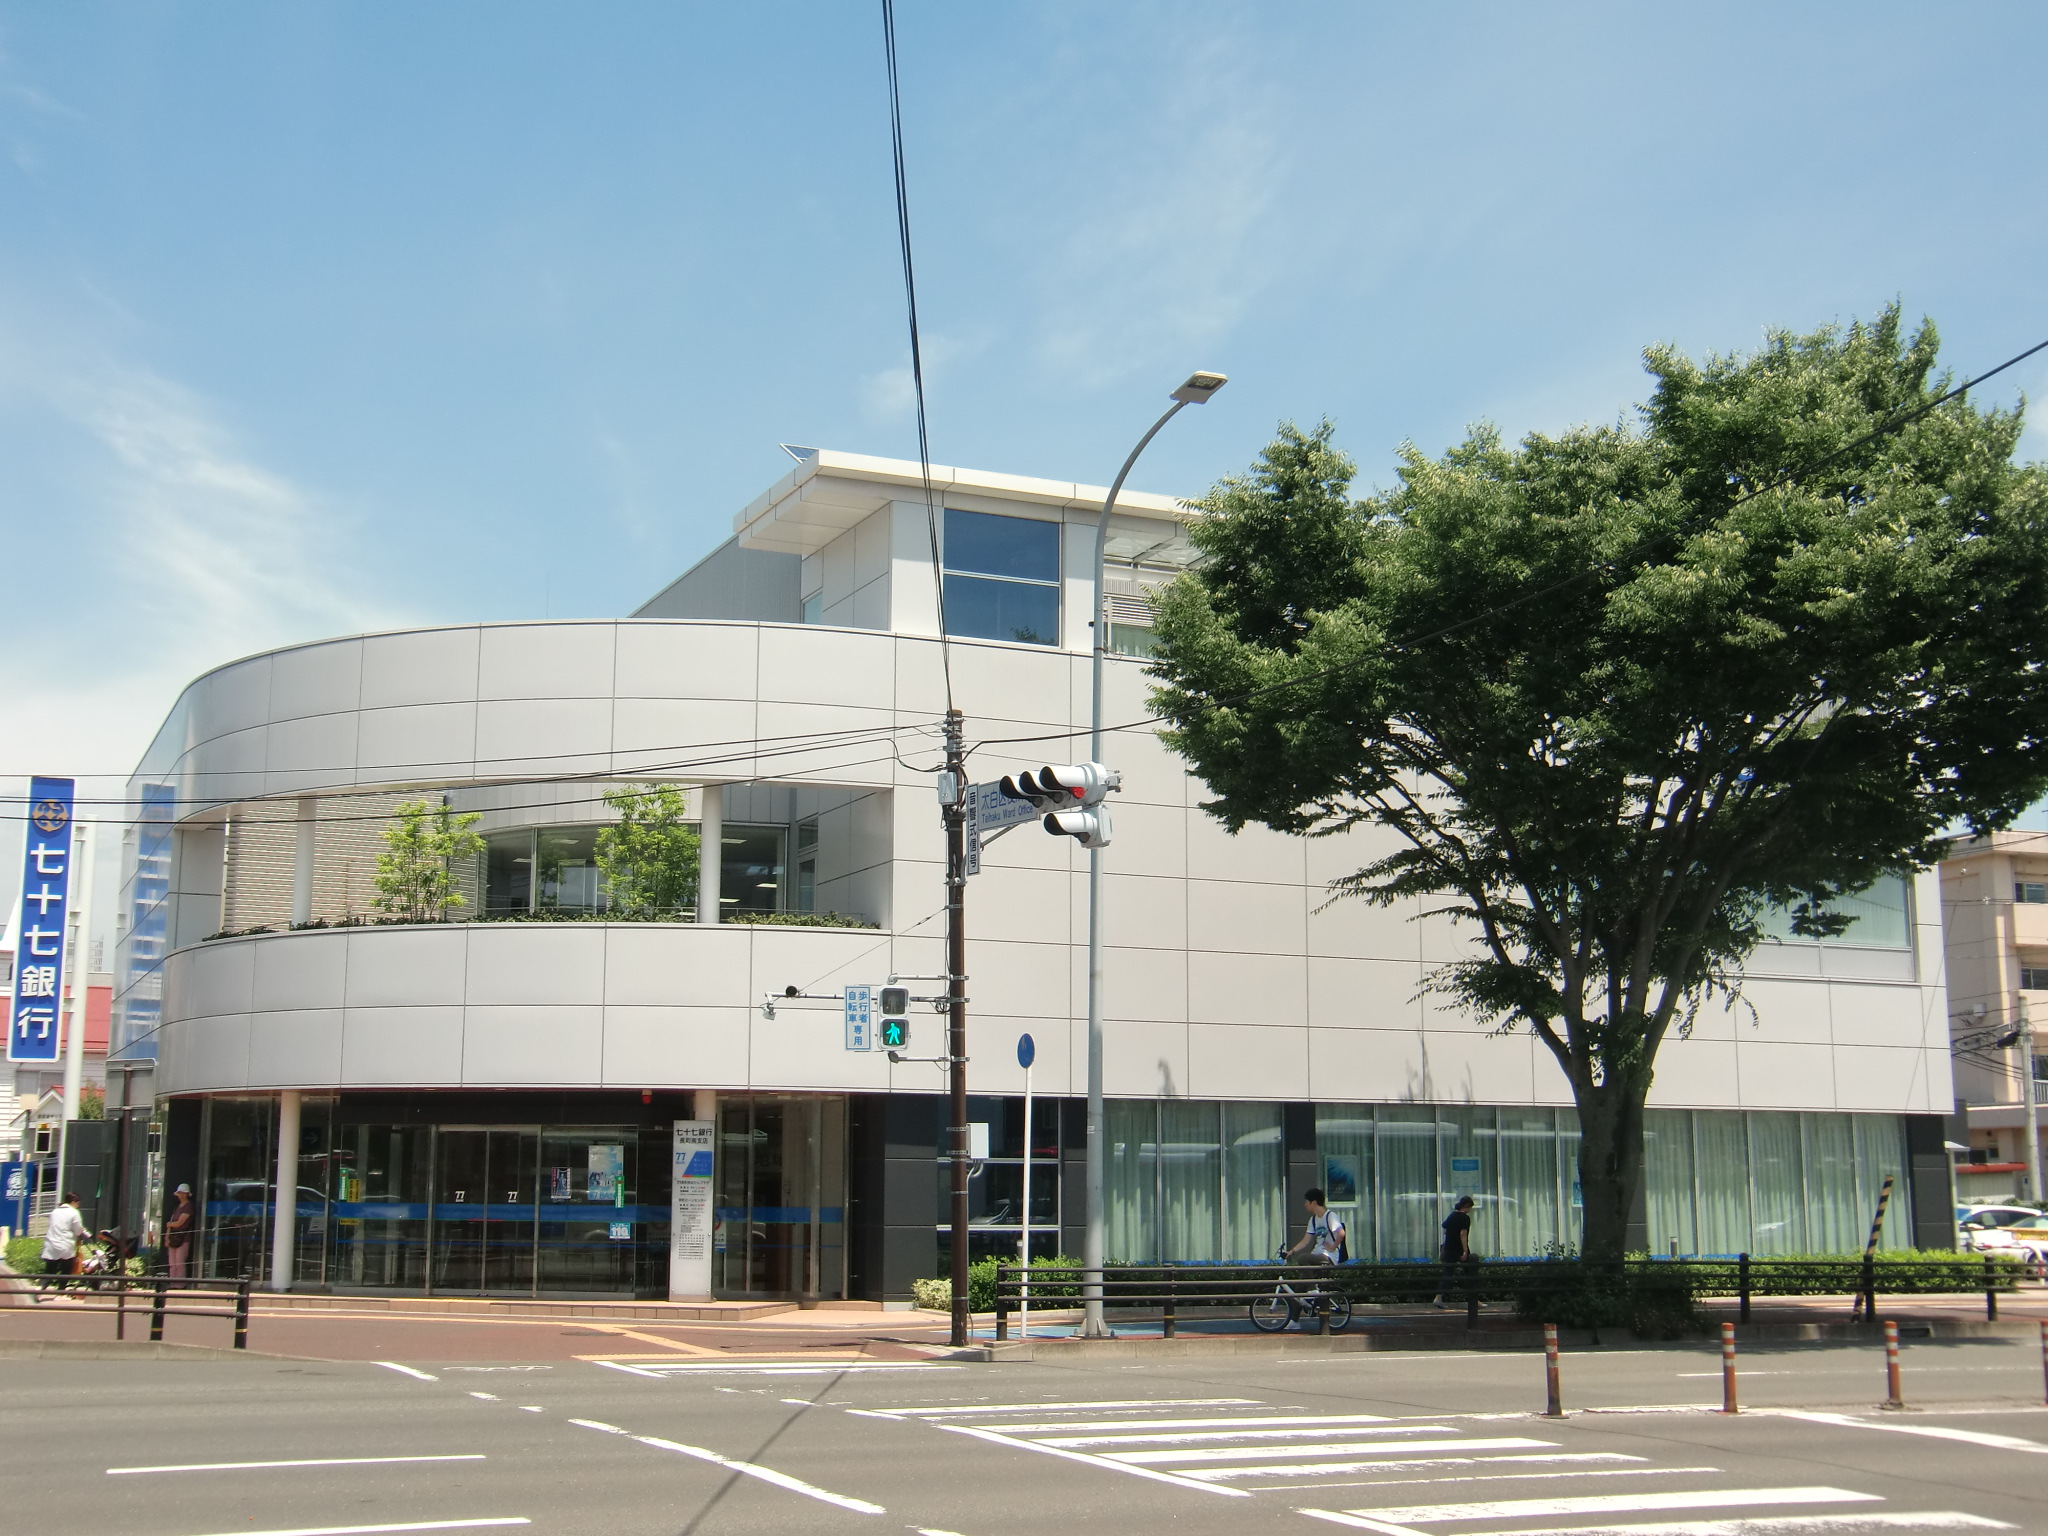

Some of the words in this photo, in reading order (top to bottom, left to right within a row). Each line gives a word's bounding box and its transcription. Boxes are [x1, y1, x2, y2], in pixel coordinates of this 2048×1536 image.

[982, 812, 1000, 824] Taihaku
[1003, 808, 1016, 818] Ward
[1018, 804, 1034, 816] Office
[18, 842, 66, 1039] 七十七銀行
[848, 990, 857, 1023] 自転車
[858, 990, 868, 1023] 歩行者
[853, 1025, 863, 1046] 専用
[676, 1128, 712, 1136] 七十七銀行
[675, 1152, 686, 1161] 77
[455, 1191, 465, 1199] 77
[507, 1191, 518, 1200] 77
